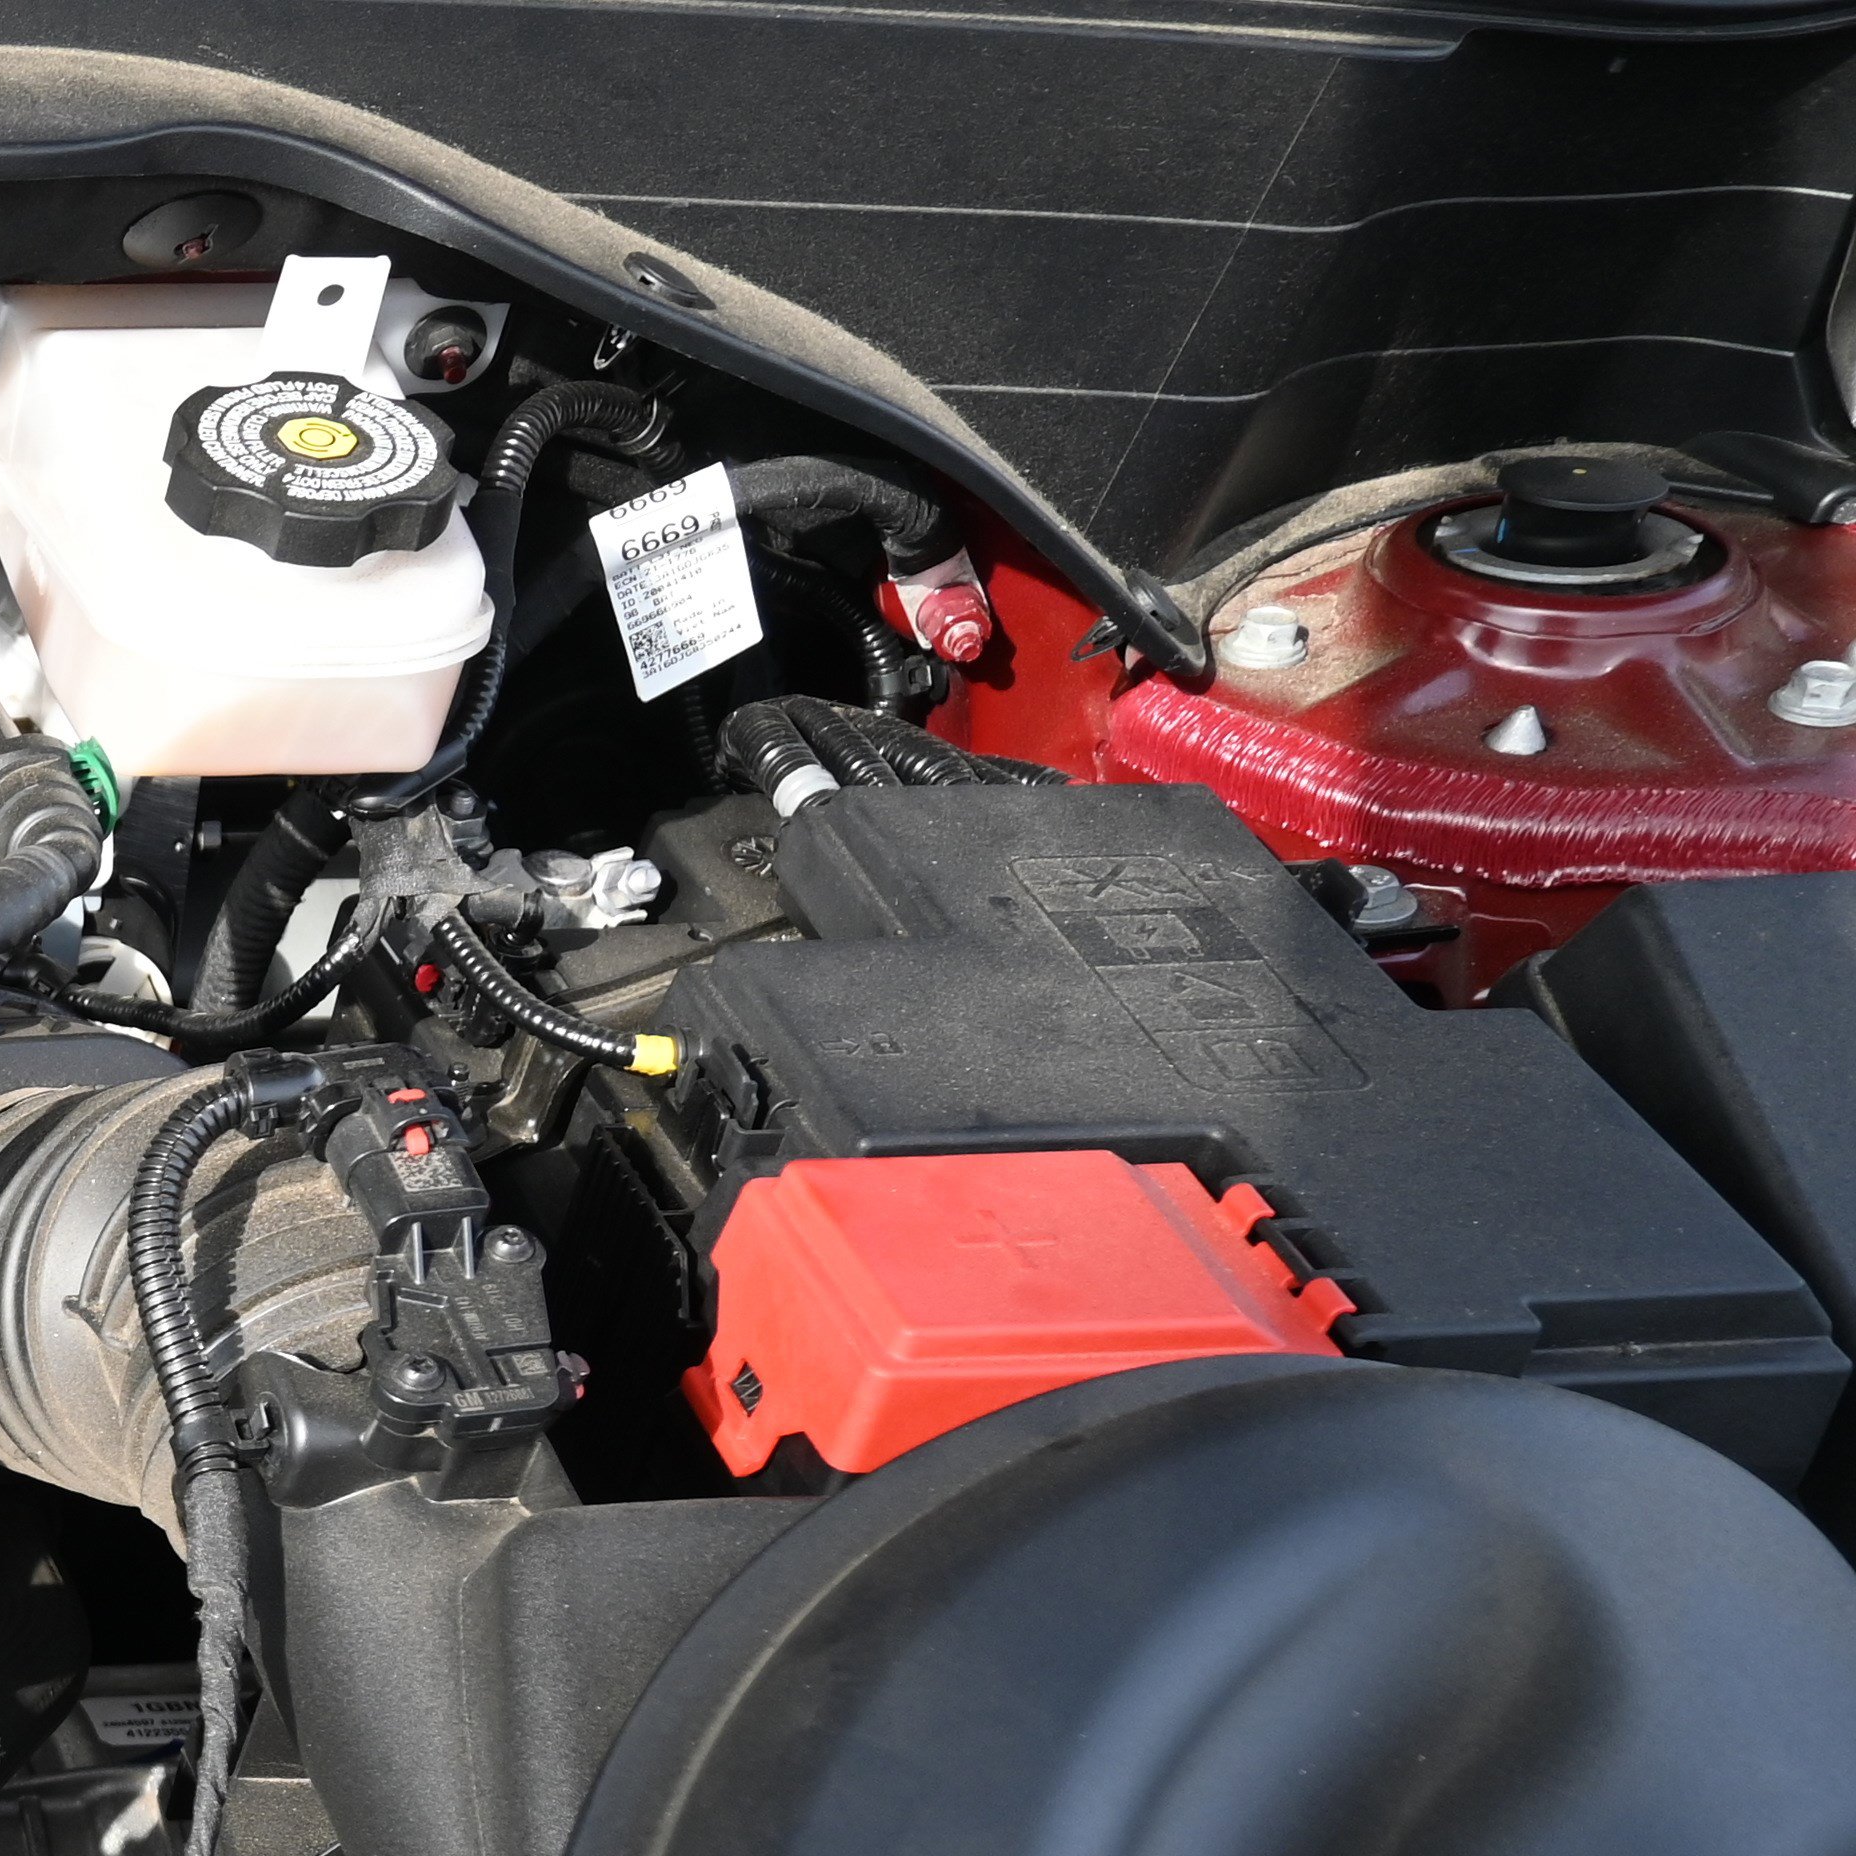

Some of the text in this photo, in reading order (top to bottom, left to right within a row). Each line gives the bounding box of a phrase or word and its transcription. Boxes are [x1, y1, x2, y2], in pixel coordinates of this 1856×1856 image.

[247, 380, 296, 395] FLUID
[293, 381, 306, 390] 4
[304, 381, 339, 393] DOT
[213, 386, 255, 408] FROM
[244, 391, 303, 408] BEFORE
[302, 391, 337, 403] CAP
[198, 408, 222, 440] SEALED
[221, 441, 248, 456] USE
[234, 454, 276, 477] ONLY
[292, 475, 321, 489] DOT
[621, 515, 700, 561] 6669
[640, 632, 706, 670] 42776669
[454, 1391, 484, 1409] GM
